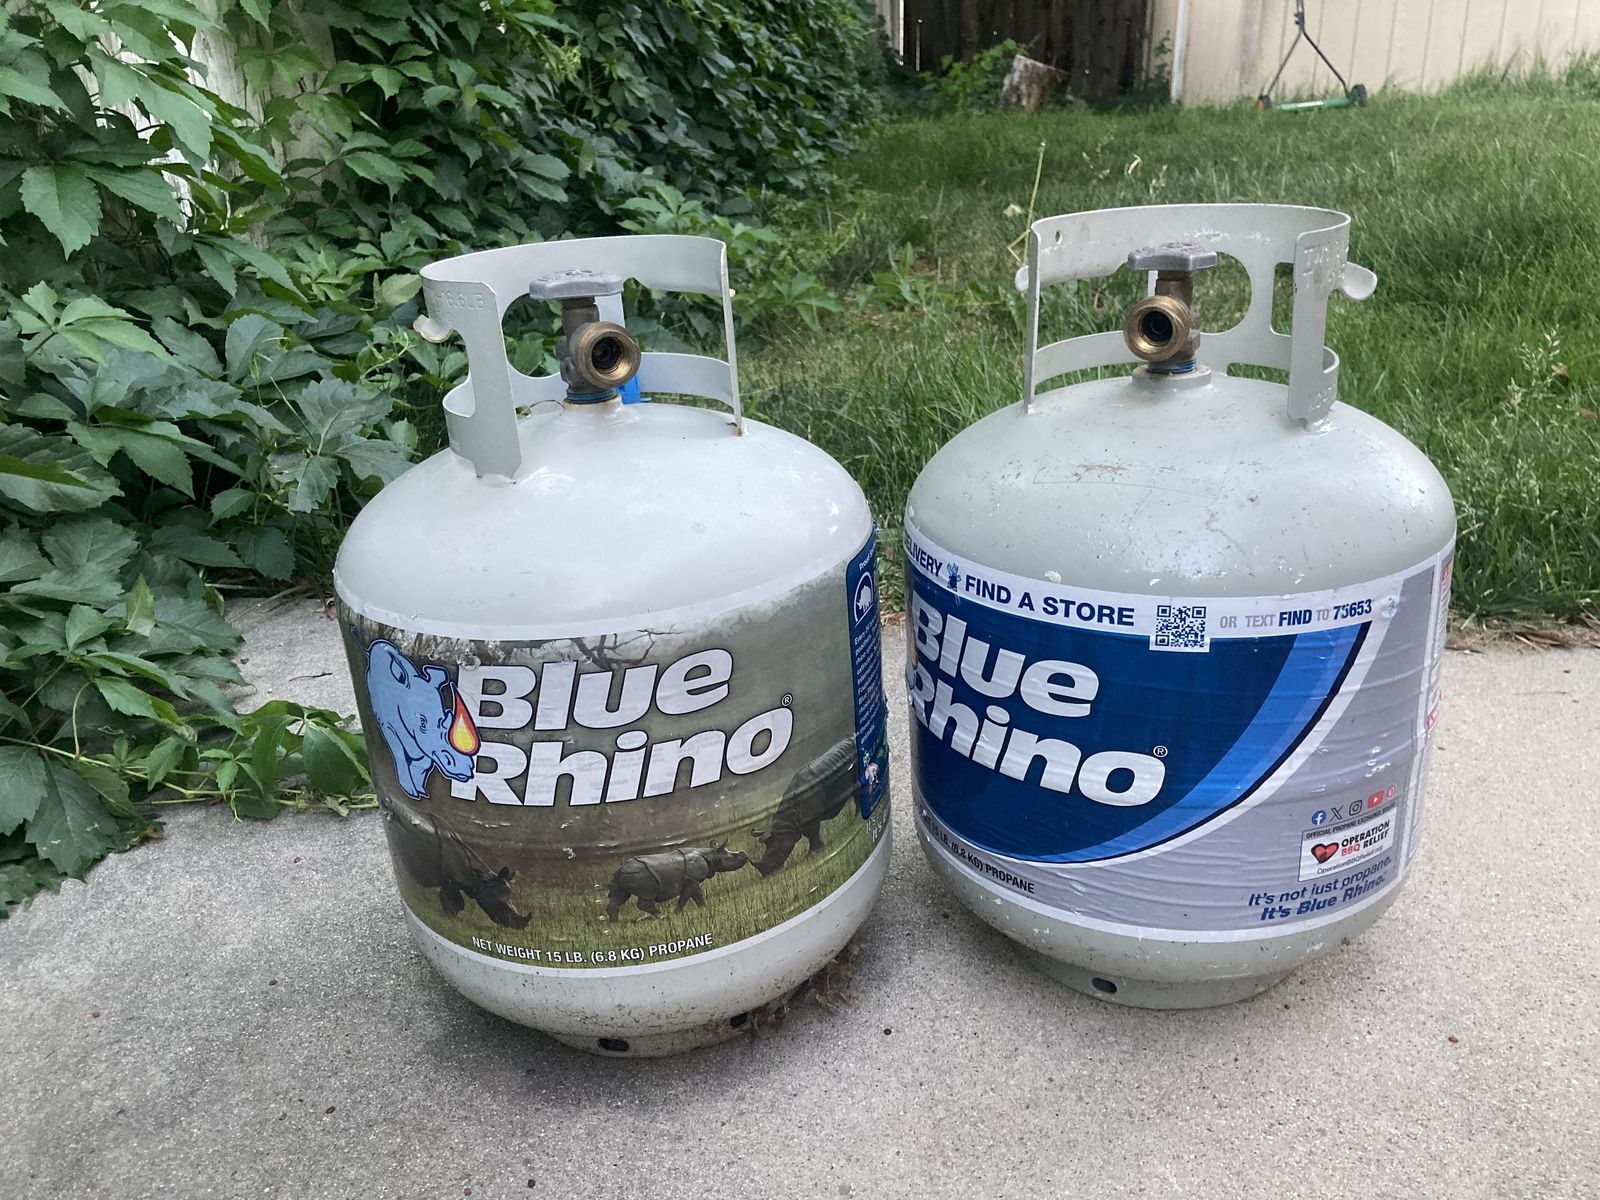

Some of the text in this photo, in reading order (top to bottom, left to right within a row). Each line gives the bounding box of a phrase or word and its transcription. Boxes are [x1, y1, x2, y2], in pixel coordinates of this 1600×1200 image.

[904, 529, 1373, 629] ELIVERY FIND A STORE OR TEXT FIND TO 75653
[911, 590, 1100, 718] Blue
[456, 647, 734, 731] Blue
[1305, 828, 1331, 840] OFFICIAL
[1341, 819, 1390, 848] OPERATION
[1341, 828, 1390, 857] BBQ RELIEF
[968, 852, 983, 872] KG)
[985, 863, 1035, 894] PROPANE
[1247, 892, 1275, 907] It's
[1279, 886, 1308, 903] not
[1260, 873, 1386, 921] It's Blue Rhino.
[471, 932, 713, 965] NET WEIGHT 15 LB. (6.8 KG) PROPANE
